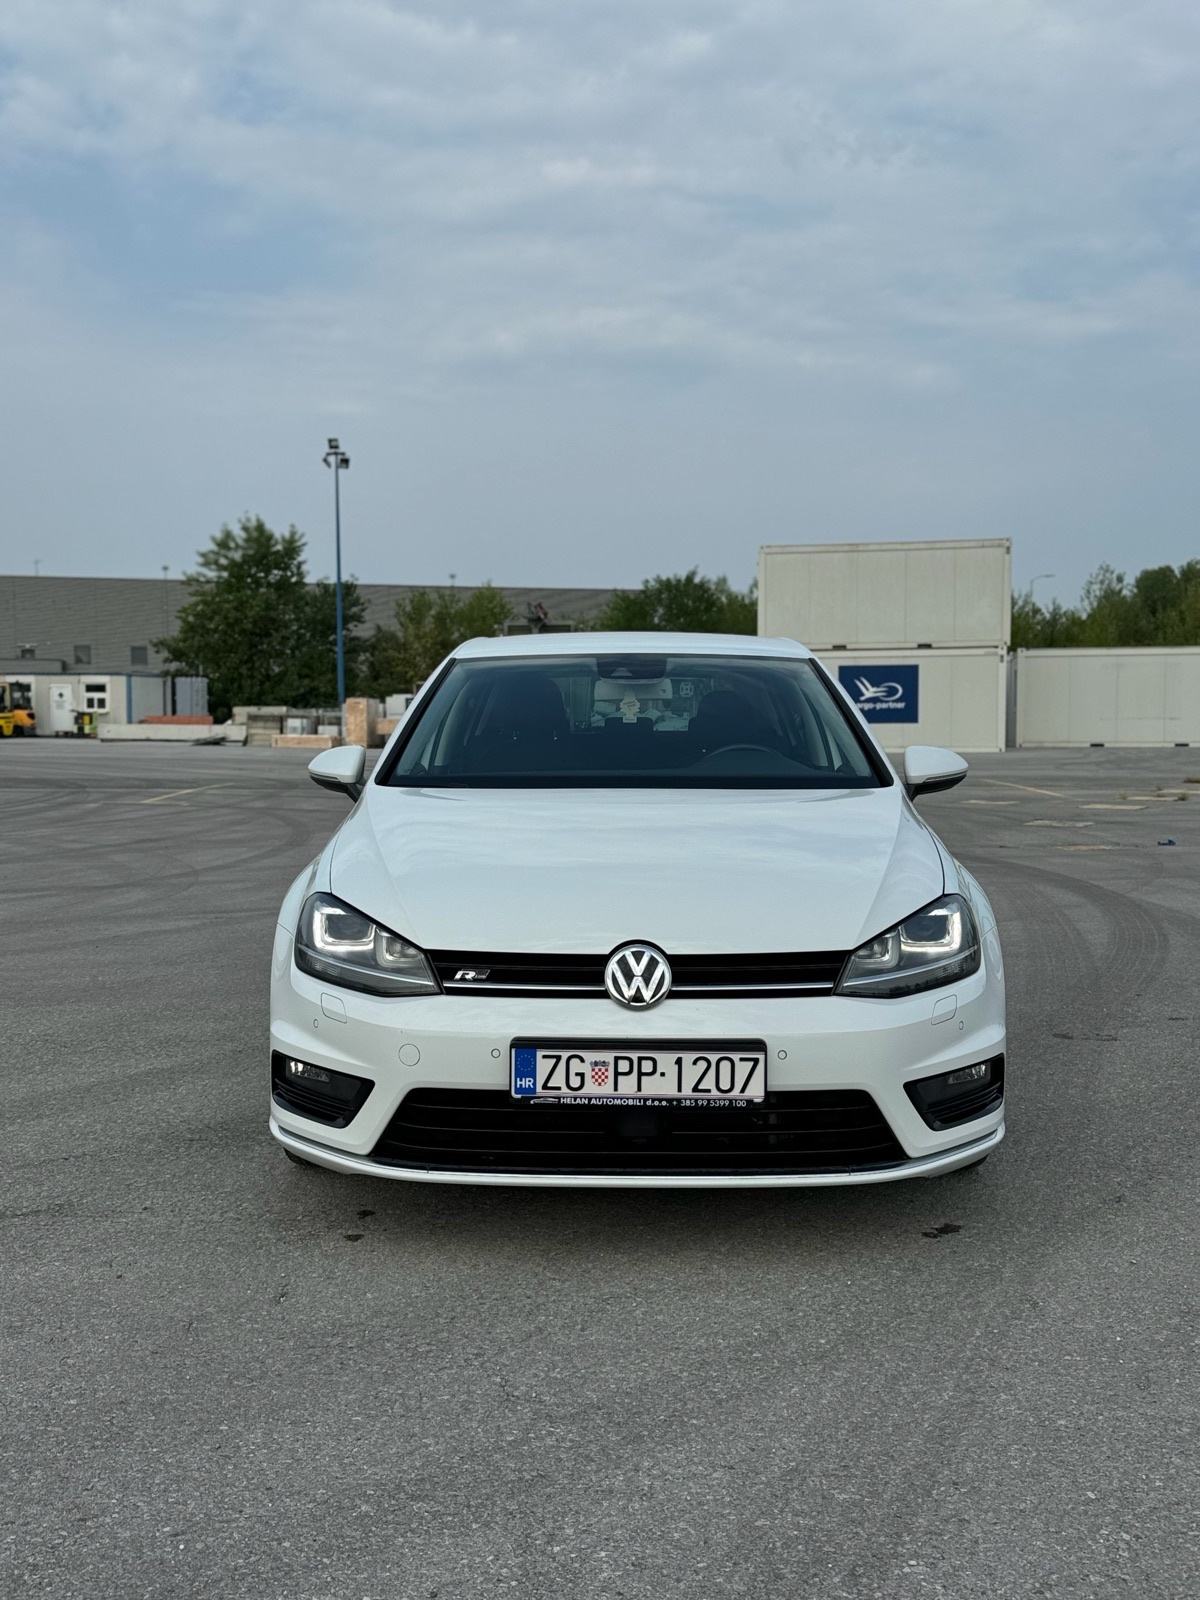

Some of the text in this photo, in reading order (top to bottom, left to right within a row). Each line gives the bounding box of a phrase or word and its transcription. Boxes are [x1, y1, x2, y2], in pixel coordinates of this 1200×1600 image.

[541, 1054, 586, 1092] ZG
[516, 1078, 534, 1089] HR
[560, 1097, 588, 1105] HELAN
[590, 1097, 643, 1106] AUTOMOBILI
[646, 1098, 669, 1106] d.o.o.
[680, 1099, 696, 1107] 385
[697, 1099, 708, 1107] 99
[709, 1099, 730, 1107] 5399
[732, 1099, 747, 1107] 100
